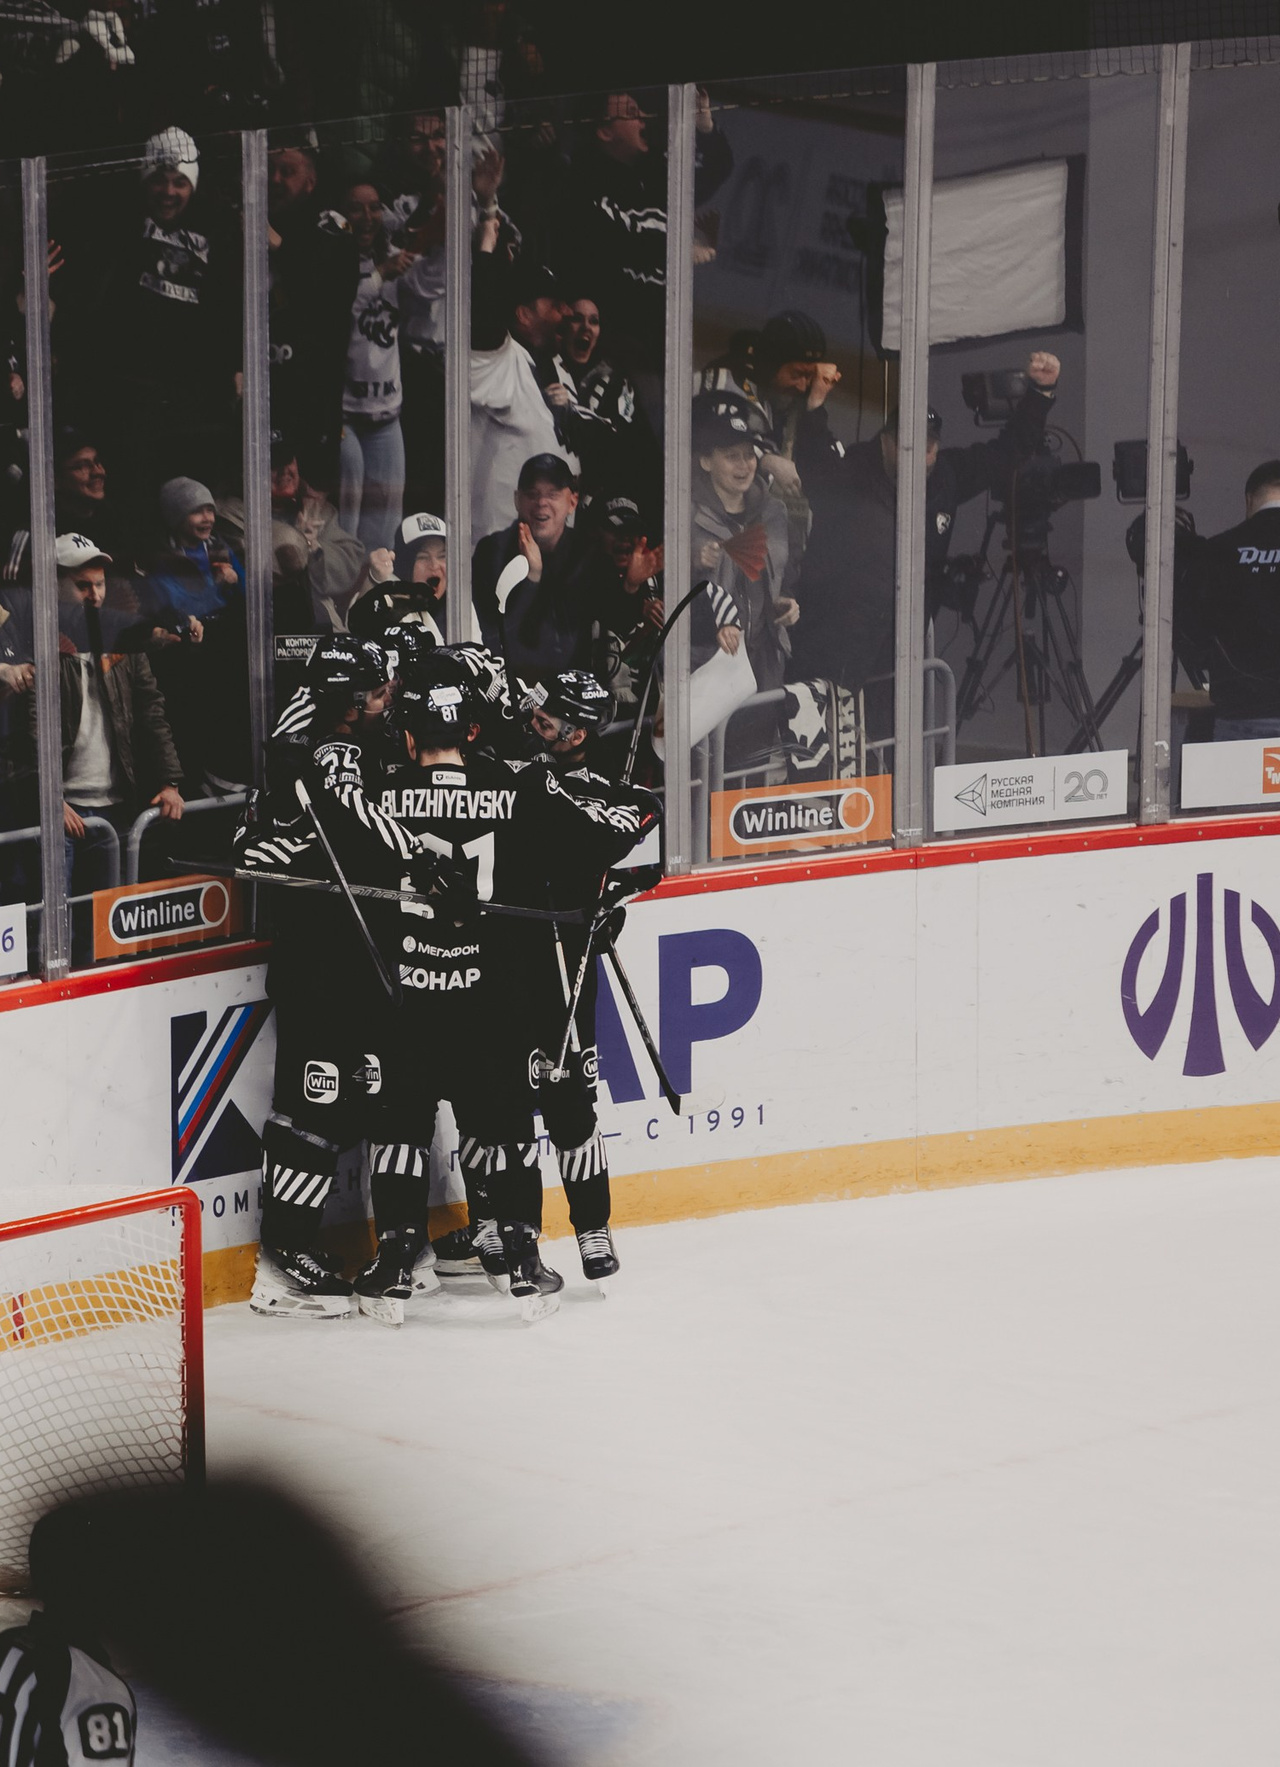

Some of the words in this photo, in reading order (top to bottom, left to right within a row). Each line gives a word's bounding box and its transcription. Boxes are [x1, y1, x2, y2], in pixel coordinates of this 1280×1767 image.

[384, 626, 401, 636] 10
[441, 705, 458, 722] 81
[991, 775, 1034, 788] РУССКАЯ
[991, 786, 1032, 799] МЕДНАЯ
[1064, 769, 1109, 803] 20
[381, 788, 517, 820] BLAZHIYEVSKY
[991, 796, 1045, 810] КОМПАНИЯ
[742, 804, 834, 833] Winline
[119, 900, 196, 932] Winline
[418, 943, 480, 959] МЕГАФОН
[399, 963, 482, 992] КОНАР
[310, 1075, 335, 1090] Win
[646, 1118, 659, 1140] С
[688, 1104, 764, 1136] 1991
[87, 1710, 129, 1754] 81
